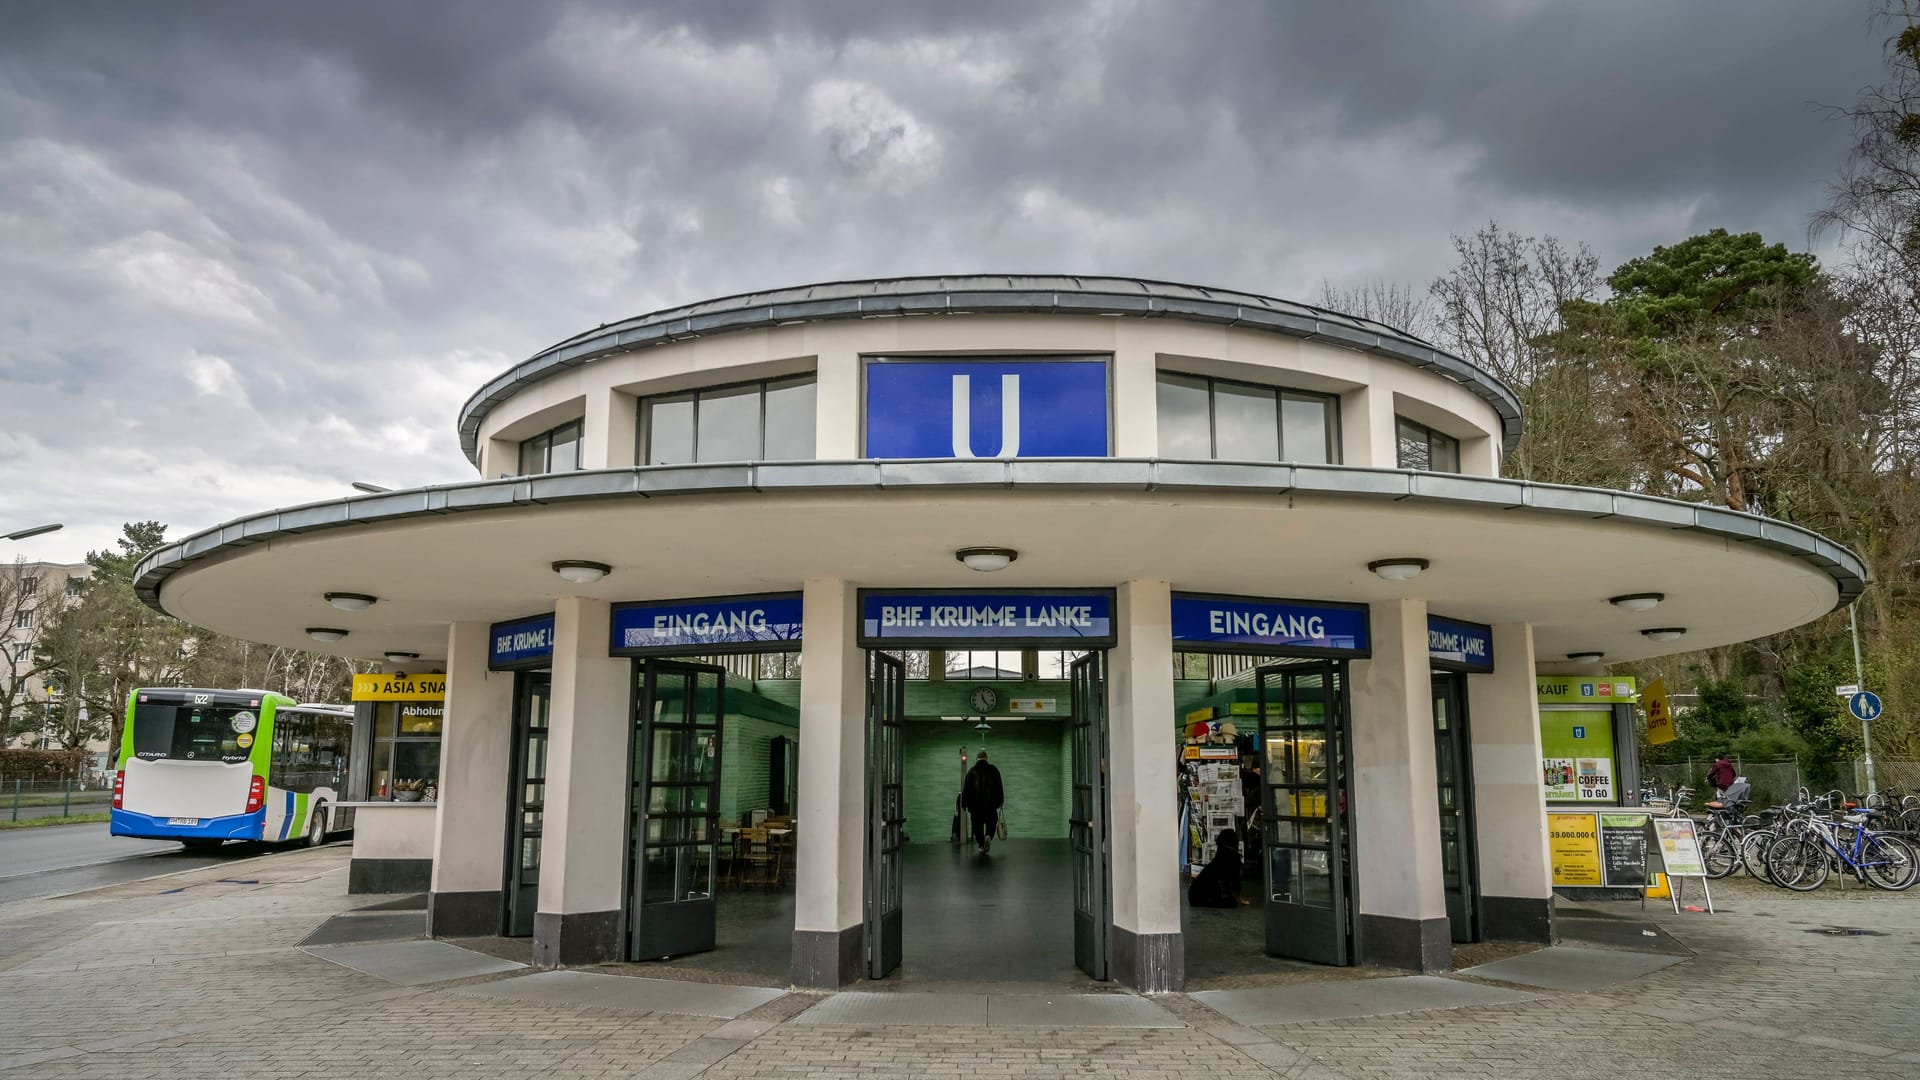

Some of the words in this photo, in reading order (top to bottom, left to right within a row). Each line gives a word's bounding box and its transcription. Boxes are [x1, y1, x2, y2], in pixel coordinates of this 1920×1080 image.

[953, 375, 1019, 457] U
[653, 609, 766, 638] EINGANG
[882, 606, 923, 627] BHF.
[930, 606, 1016, 627] KRUMME
[1025, 606, 1092, 627] LANKE
[1209, 610, 1325, 639] EINGANG
[497, 635, 513, 654] BHF.
[513, 628, 546, 652] KRUMME
[1460, 635, 1485, 657] LANKE
[383, 681, 415, 694] ASIA
[194, 694, 209, 705] 622
[1648, 717, 1667, 729] LOTTO
[1578, 775, 1609, 785] COFFEE
[1582, 789, 1593, 798] TO
[1595, 789, 1608, 798] GO
[1550, 831, 1590, 839] 39.000.000
[1590, 831, 1596, 839] €
